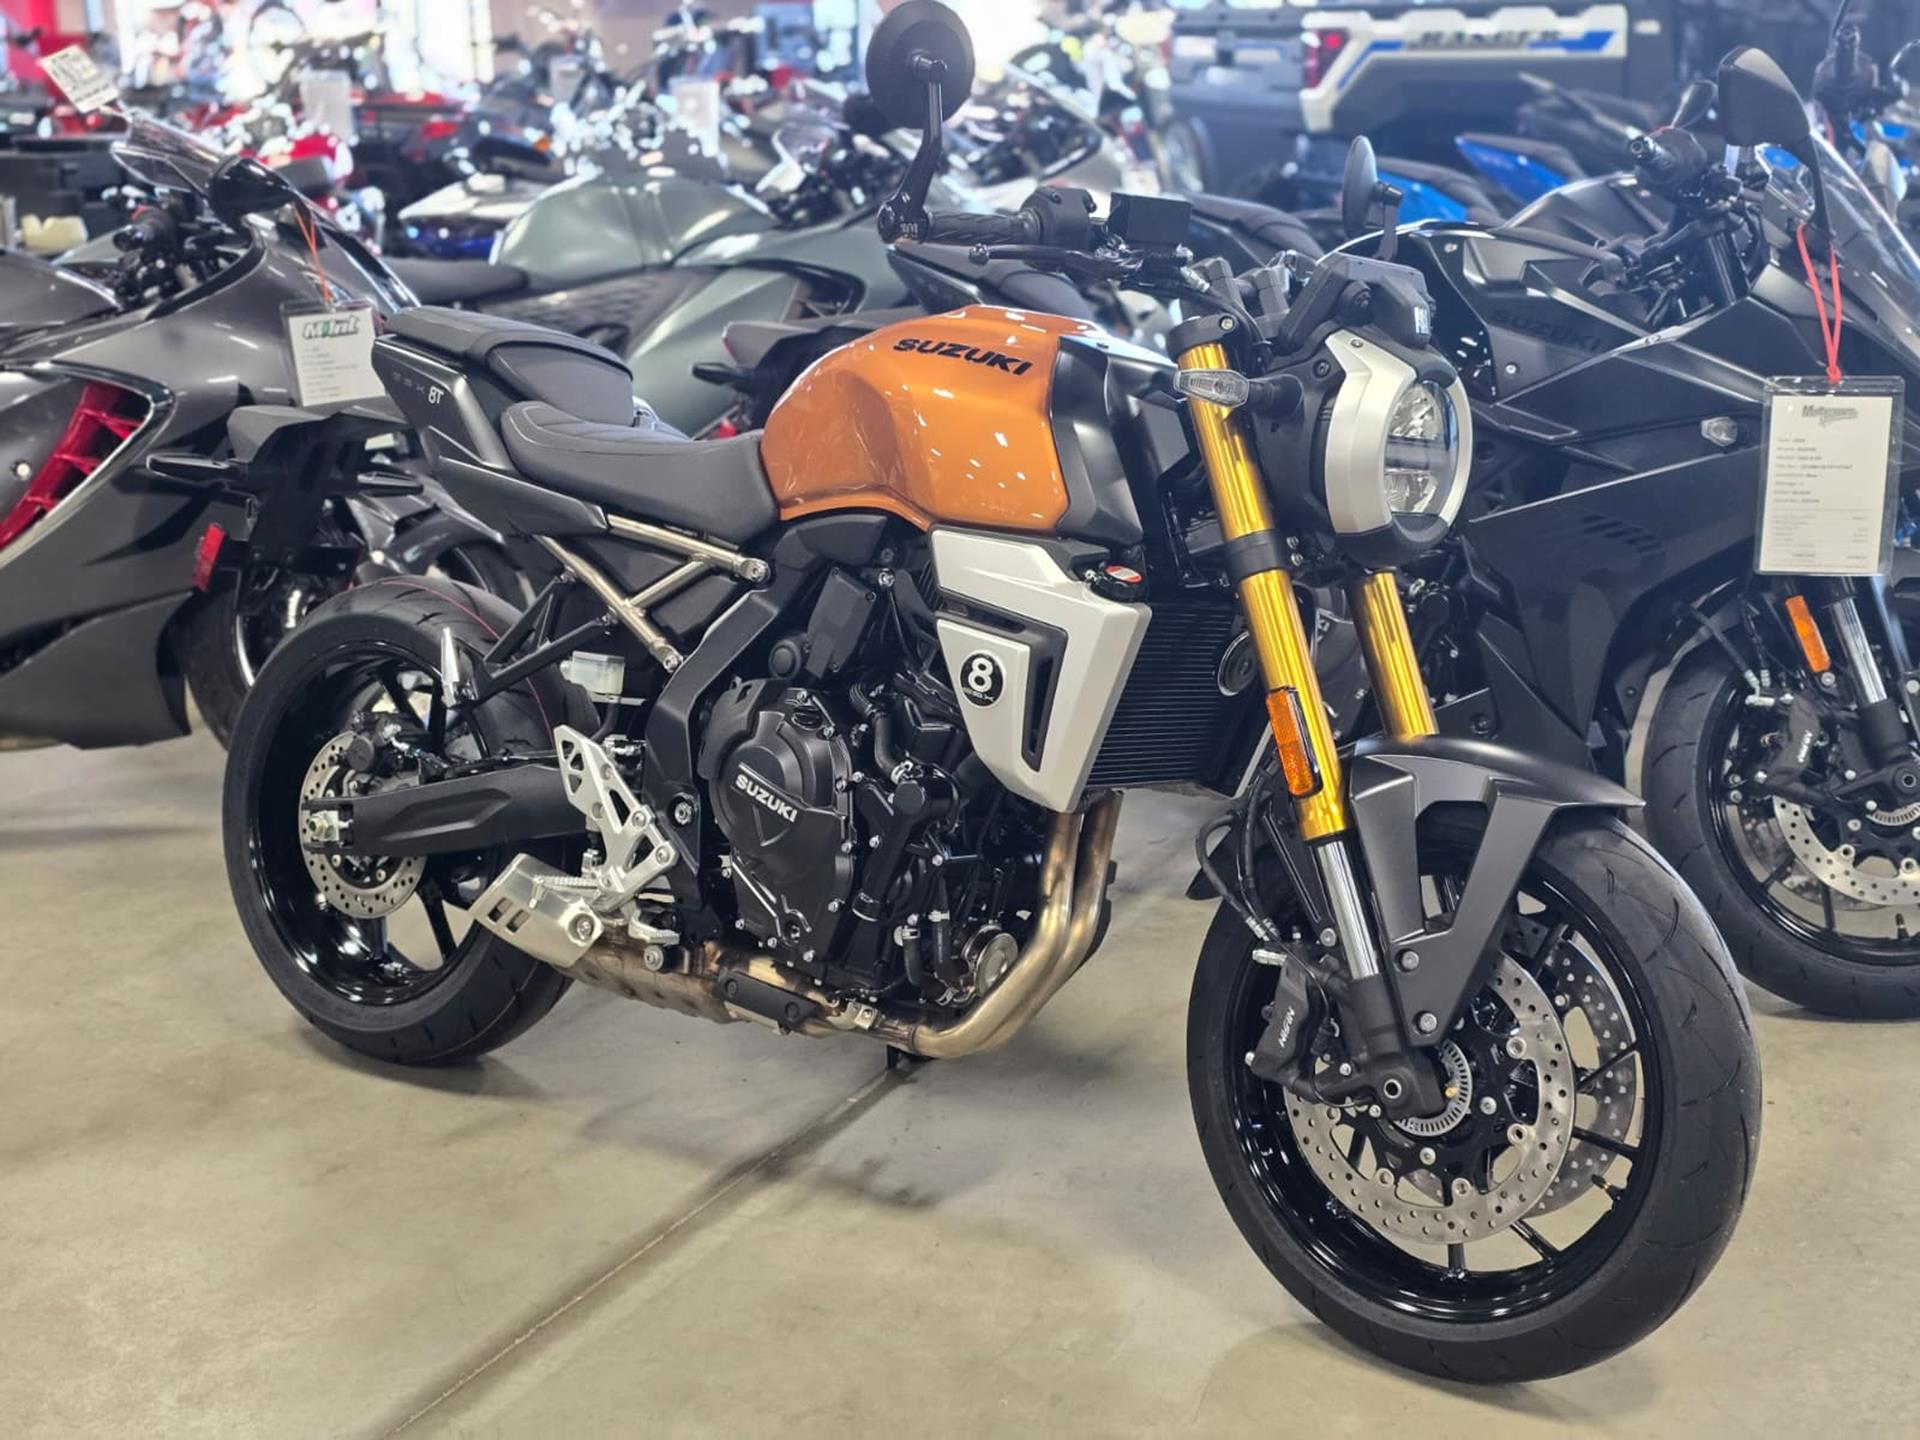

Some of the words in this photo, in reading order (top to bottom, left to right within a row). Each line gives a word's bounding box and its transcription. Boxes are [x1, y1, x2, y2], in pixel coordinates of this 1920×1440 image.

[1490, 309, 1602, 350] SUZUKI
[893, 338, 1033, 376] SUZUKI
[428, 386, 445, 404] 8T
[968, 657, 993, 692] 8
[735, 774, 798, 823] SUZUKI
